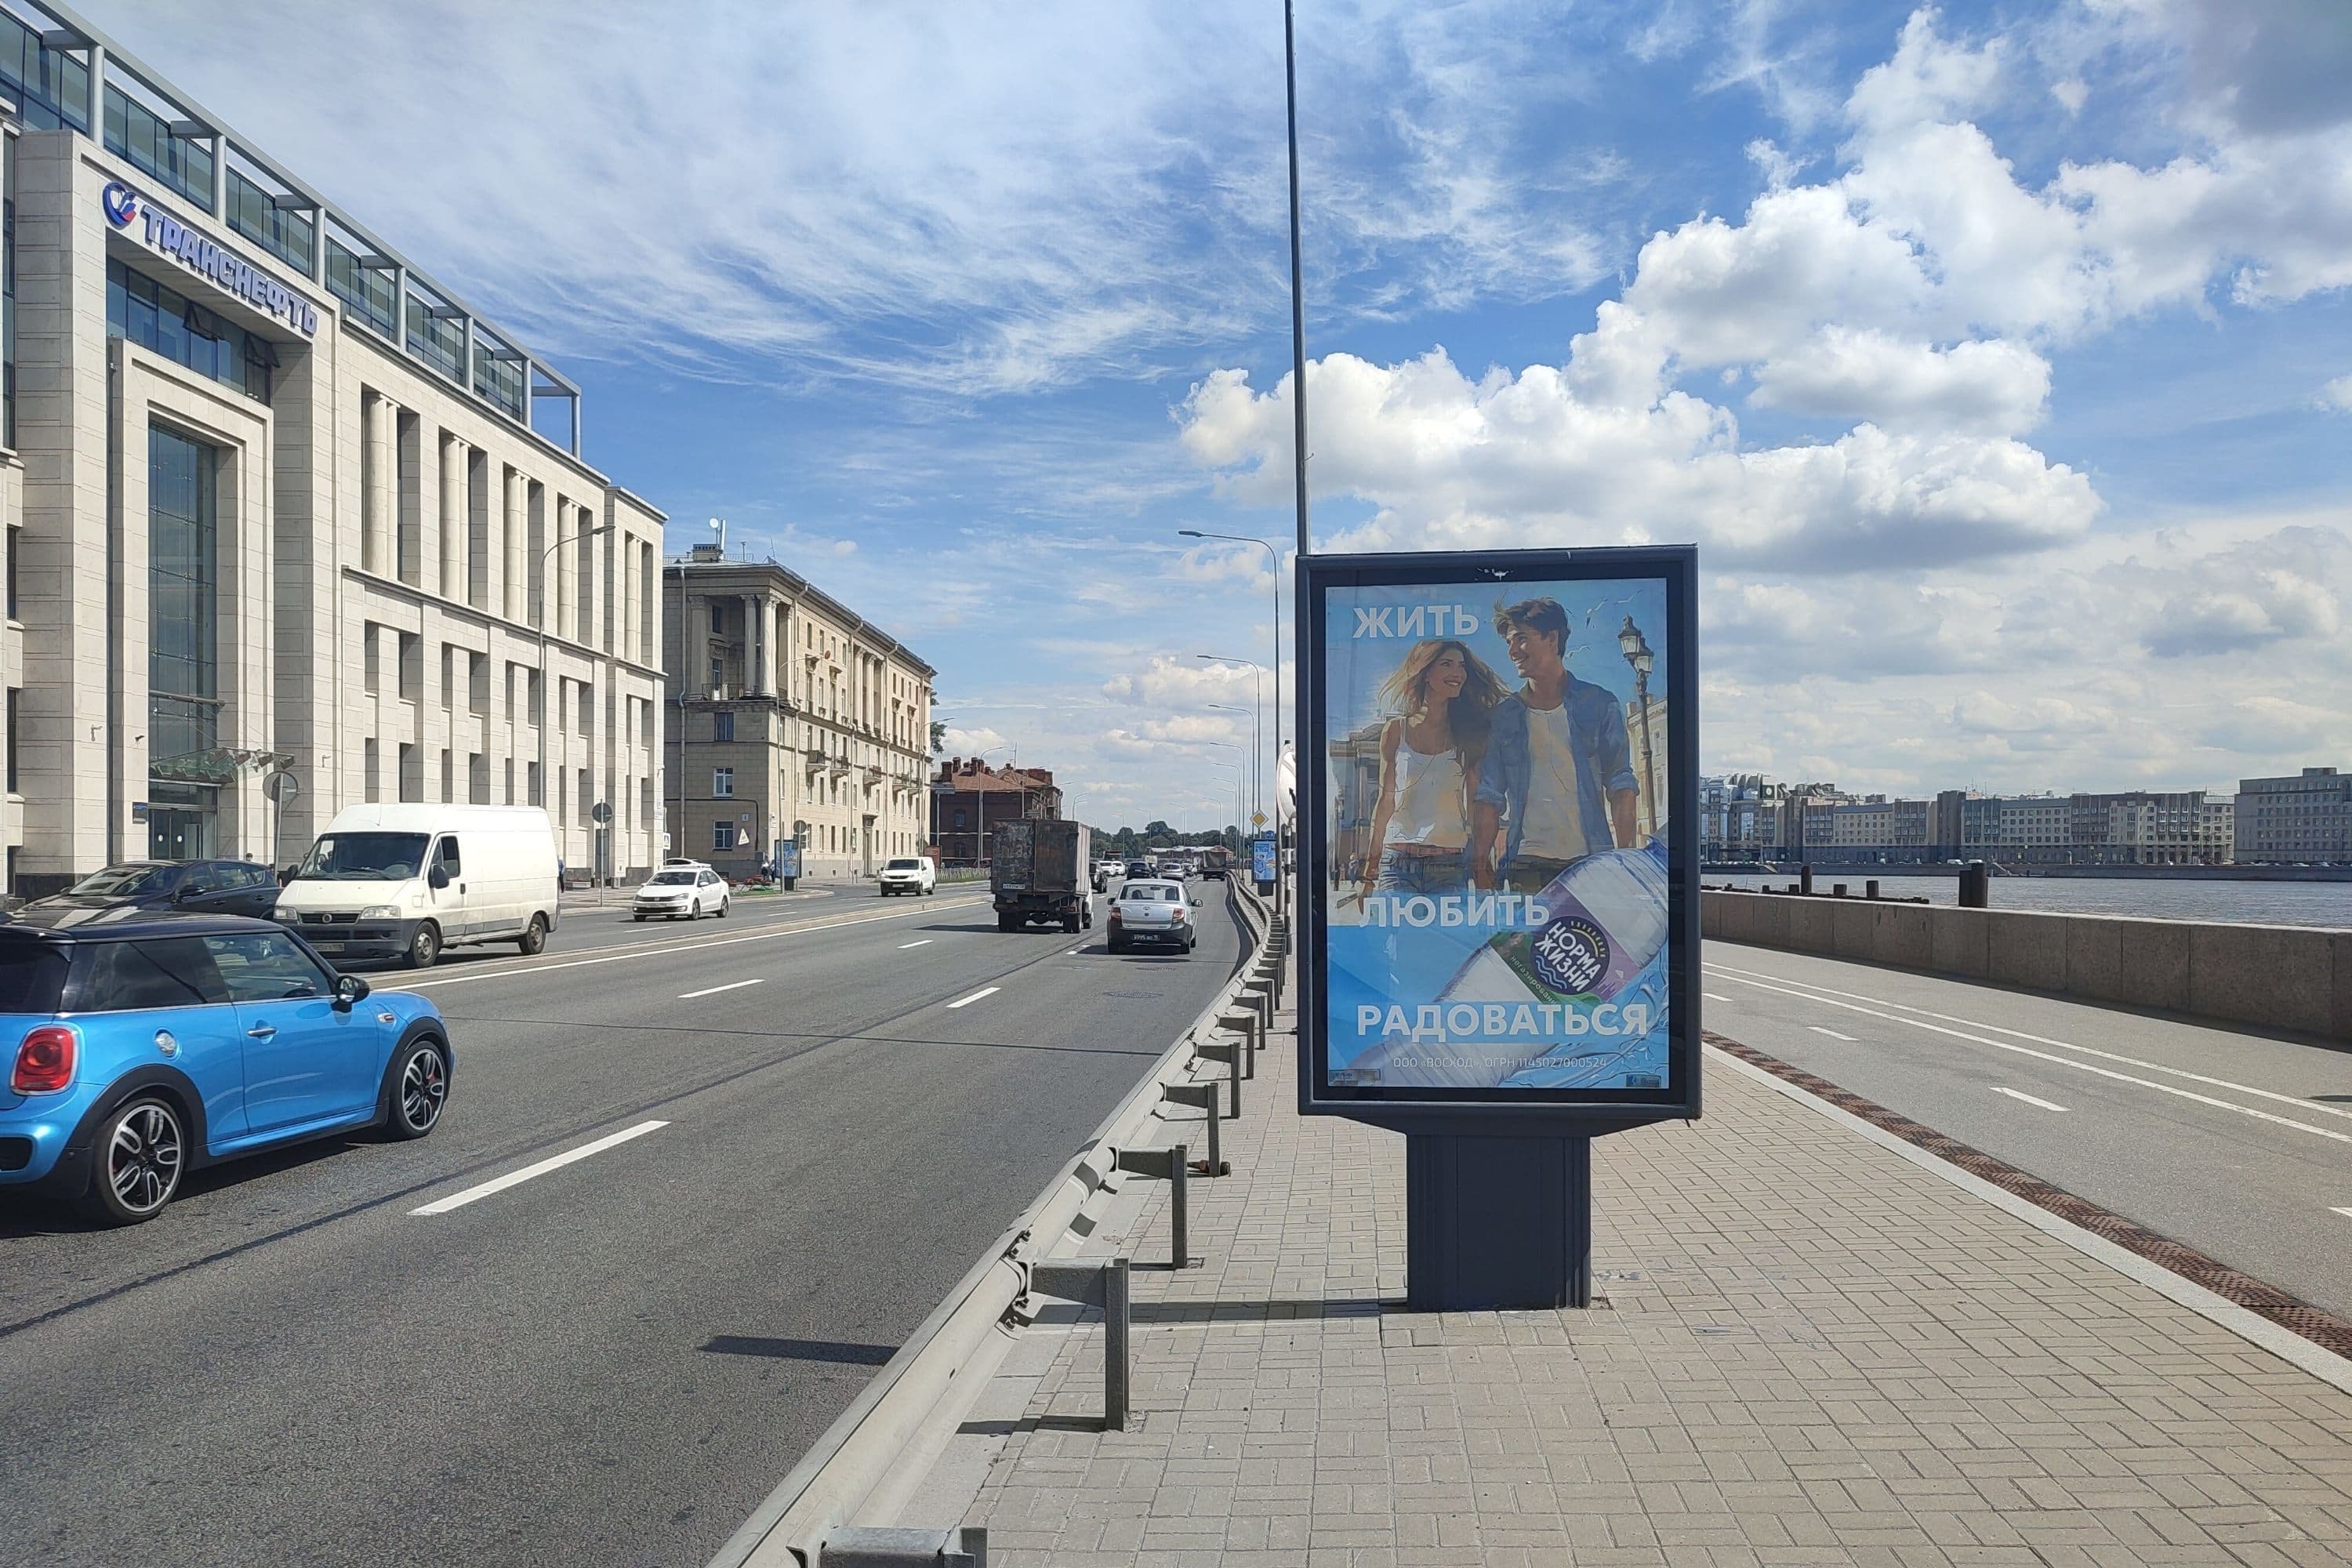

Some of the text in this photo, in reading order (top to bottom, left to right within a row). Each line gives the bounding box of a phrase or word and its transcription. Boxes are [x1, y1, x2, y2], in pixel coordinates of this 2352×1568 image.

[140, 204, 318, 338] ТРАНСНЕФТЬ
[1352, 604, 1479, 638] ЖИТЬ
[1359, 895, 1550, 927] ЛЮБИТЬ
[1534, 934, 1591, 992] ЖИЗНИ
[1548, 921, 1601, 980] НОРМА
[1357, 1004, 1648, 1043] РАДОВАТЬСЯ
[1393, 1058, 1417, 1067] ООО
[1485, 1058, 1515, 1067] ОГРН
[1519, 1058, 1606, 1067] 1145027000524
